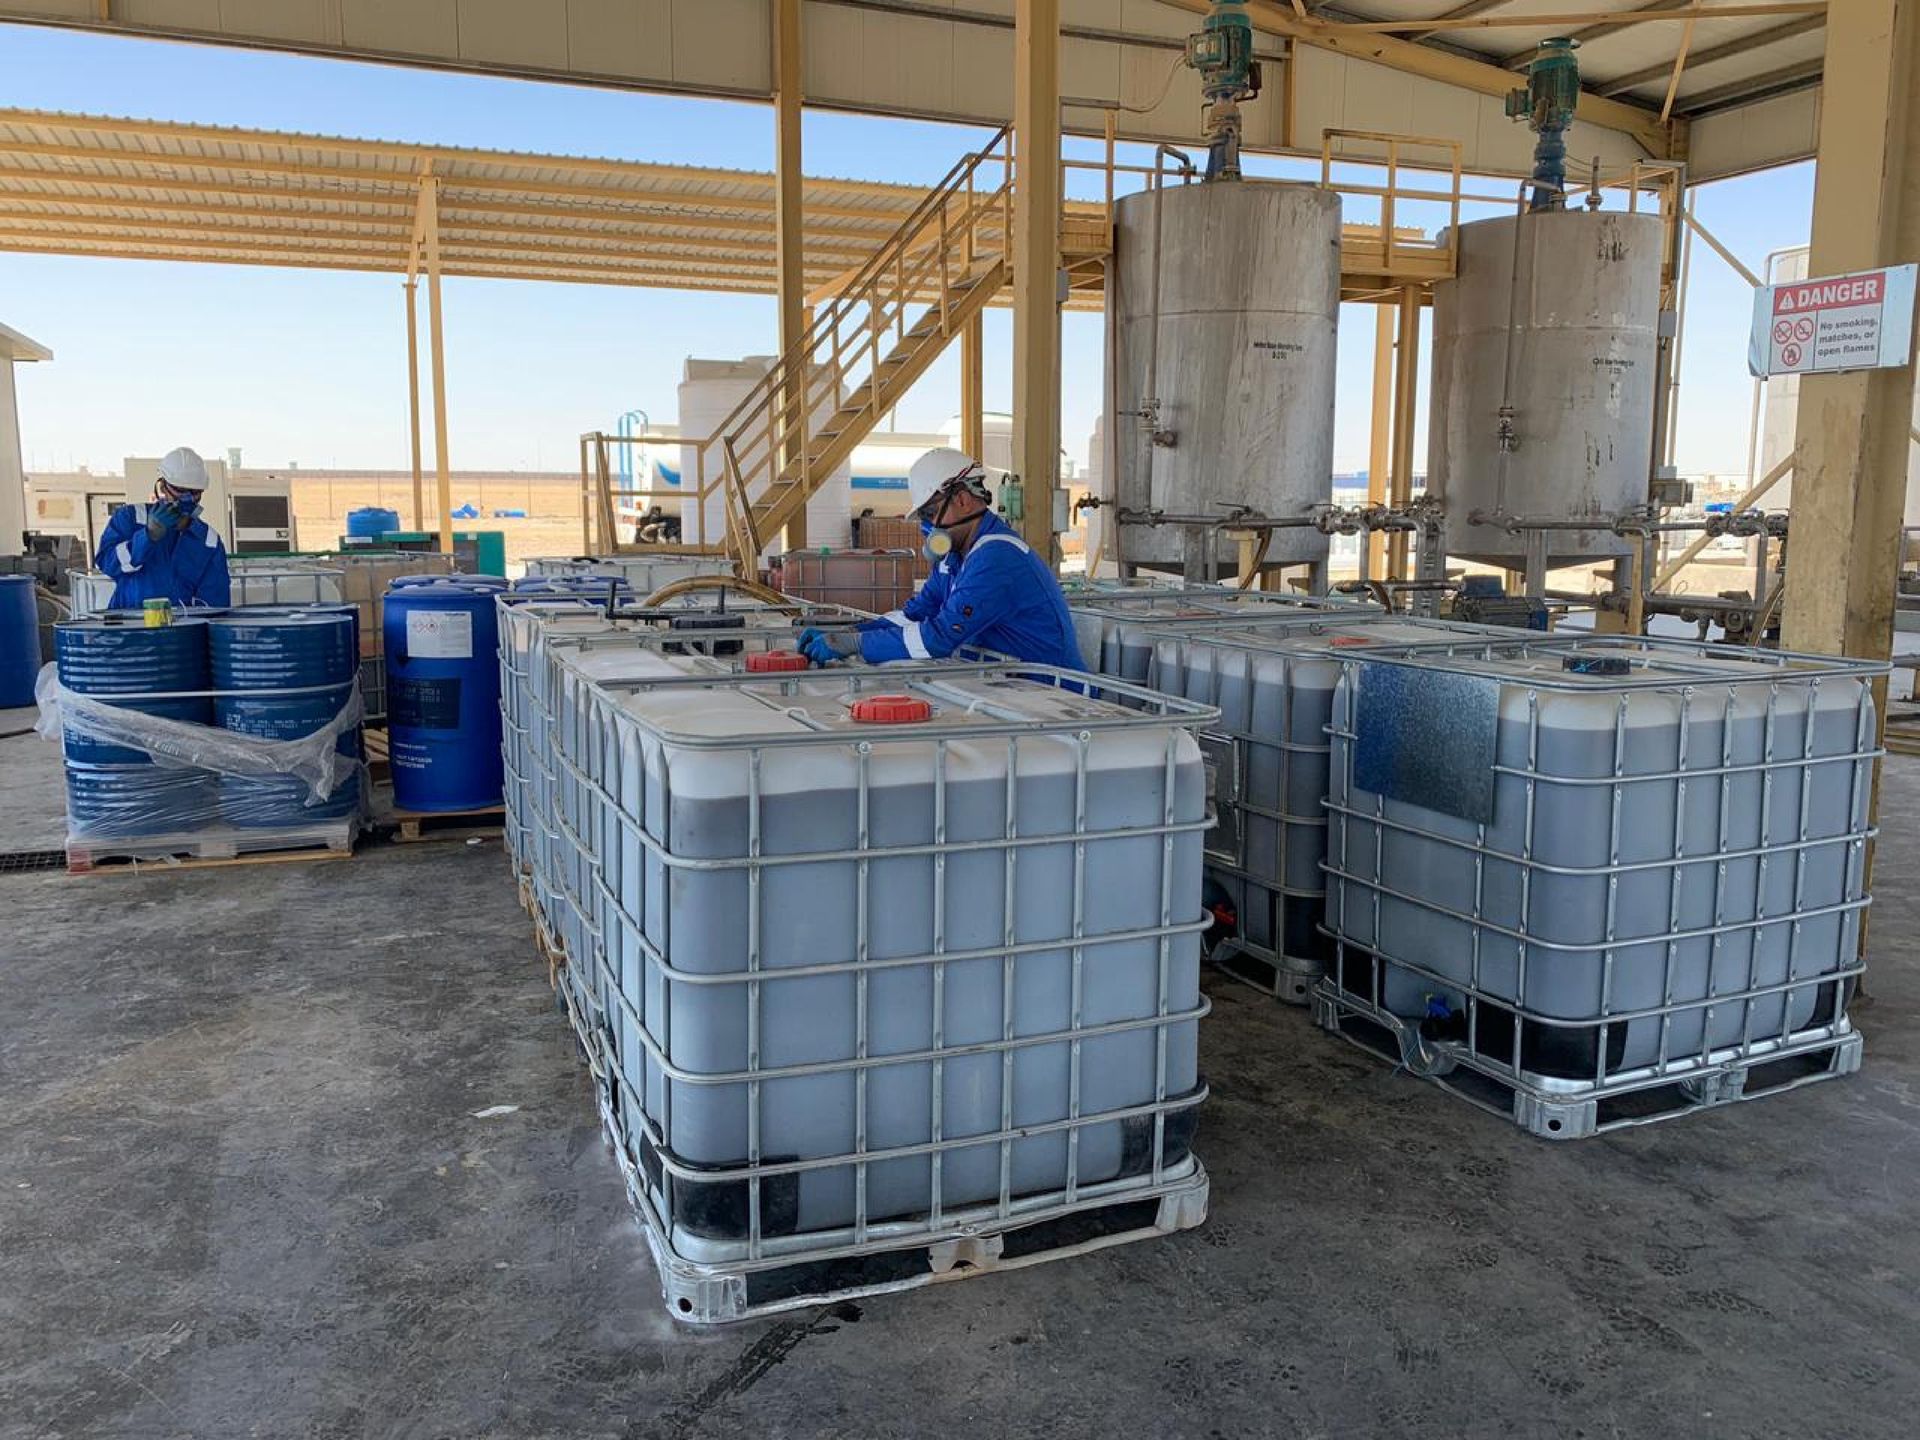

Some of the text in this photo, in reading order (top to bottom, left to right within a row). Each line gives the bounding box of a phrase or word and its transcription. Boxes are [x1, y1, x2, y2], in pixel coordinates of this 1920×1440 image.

[1798, 280, 1877, 307] DANGER
[1820, 321, 1834, 331] No
[1819, 331, 1875, 344] matches, or
[1817, 344, 1876, 357] open flames
